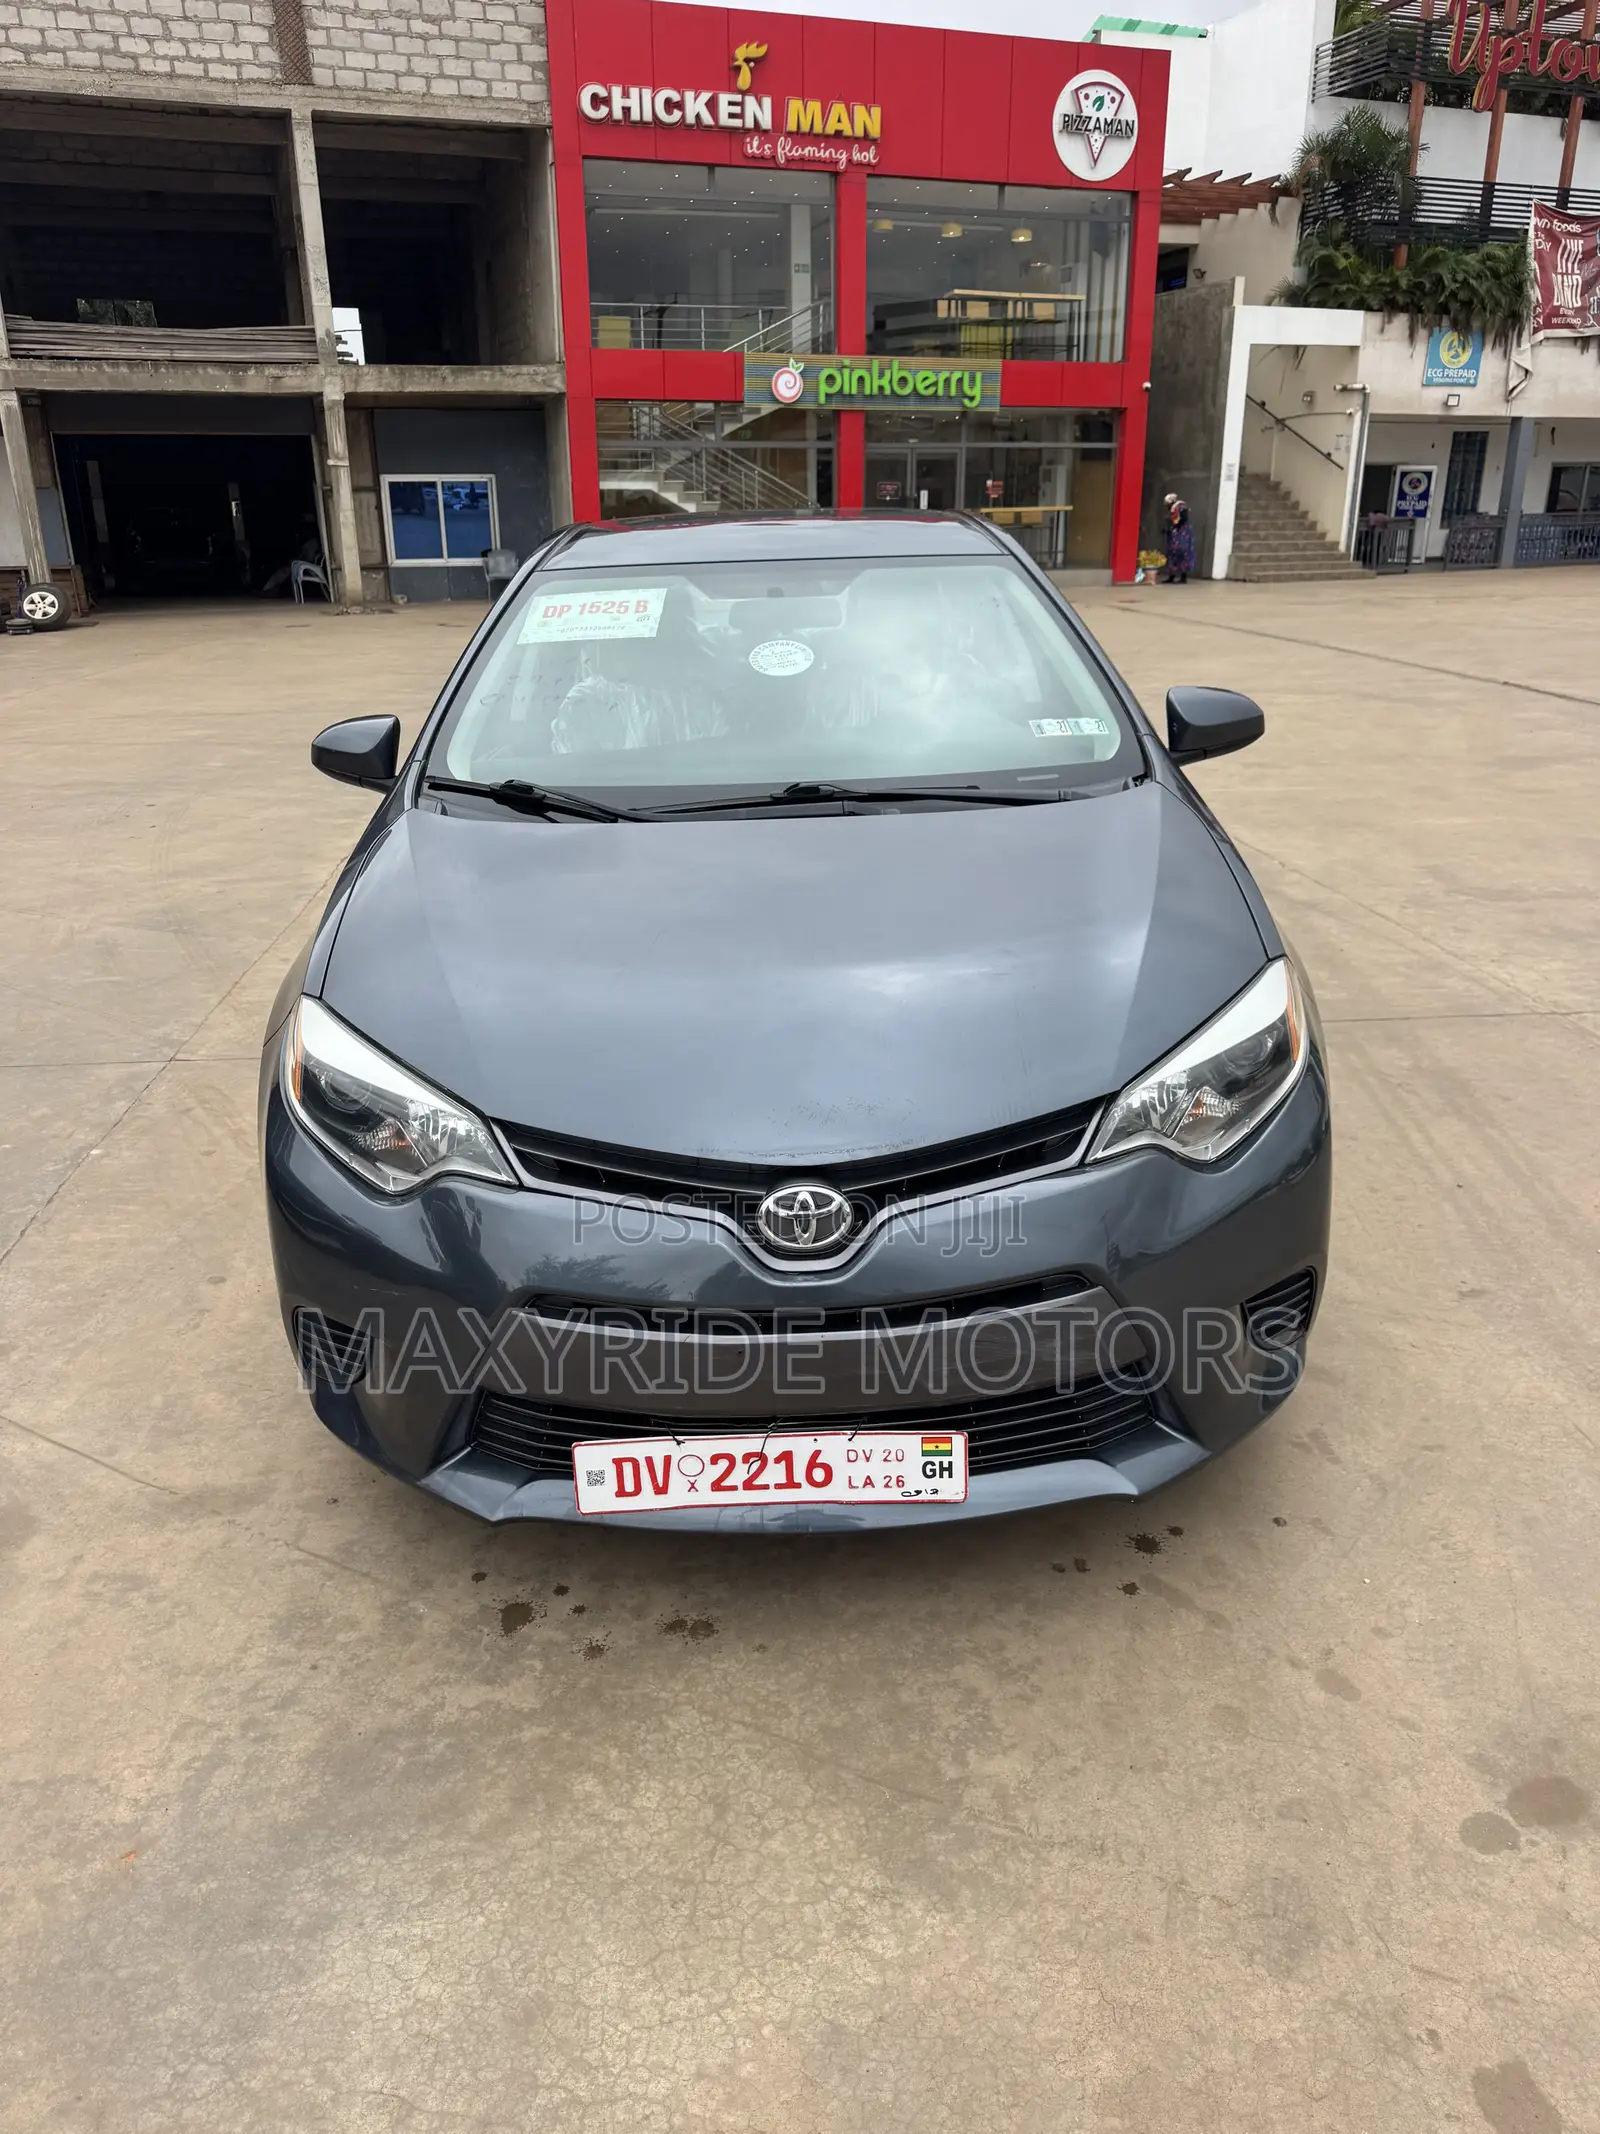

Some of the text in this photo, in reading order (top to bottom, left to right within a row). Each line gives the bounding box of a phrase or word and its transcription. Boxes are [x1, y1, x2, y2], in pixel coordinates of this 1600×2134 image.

[579, 82, 882, 140] CHICKEN MAN
[1062, 112, 1136, 137] PIZZAMAN
[746, 135, 773, 156] it's
[776, 136, 848, 169] flaming
[1552, 218, 1582, 233] foods
[1557, 239, 1584, 274] LIVE
[819, 359, 982, 408] pinkberry
[1427, 368, 1477, 378] ECG PREPAID
[542, 599, 650, 618] DP 1525 B
[846, 1448, 905, 1463] DV 20
[612, 1455, 672, 1498] DV
[710, 1450, 834, 1492] 2216
[921, 1460, 954, 1480] GH
[847, 1474, 906, 1489] LA 26
